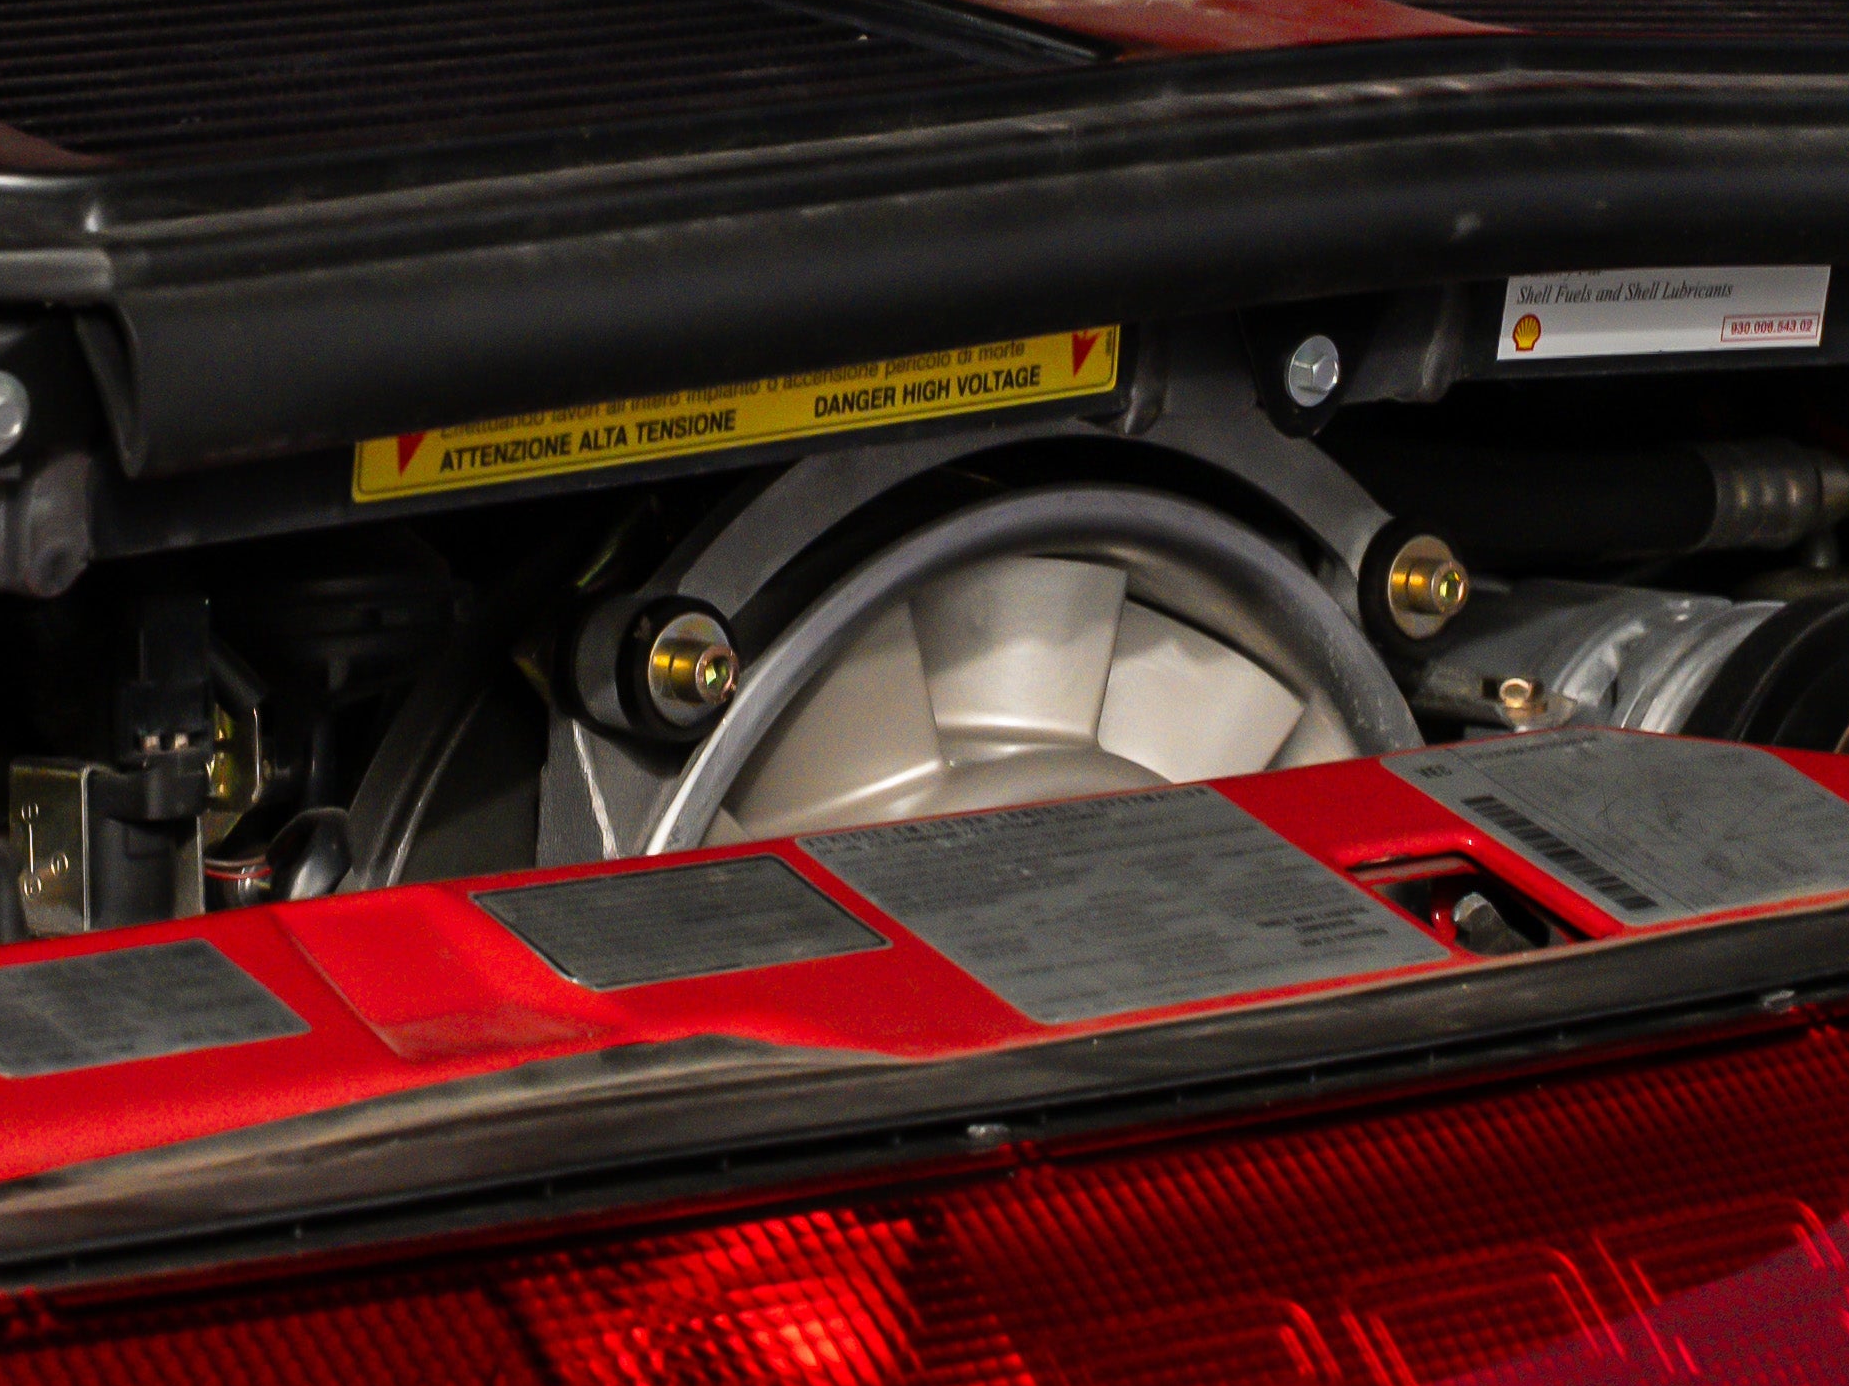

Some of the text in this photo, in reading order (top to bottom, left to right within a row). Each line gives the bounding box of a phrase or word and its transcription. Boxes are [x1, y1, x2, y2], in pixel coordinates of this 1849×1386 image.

[1517, 280, 1734, 304] Shell Fuels and Shell Lubricants
[686, 380, 761, 405] impianto
[885, 349, 951, 379] pericolo
[956, 346, 973, 365] di
[978, 340, 1026, 362] morte
[814, 364, 1042, 419] DANGER HIGH VOLTAGE
[439, 409, 737, 473] ATTENZIONE ALTA TENSIONE
